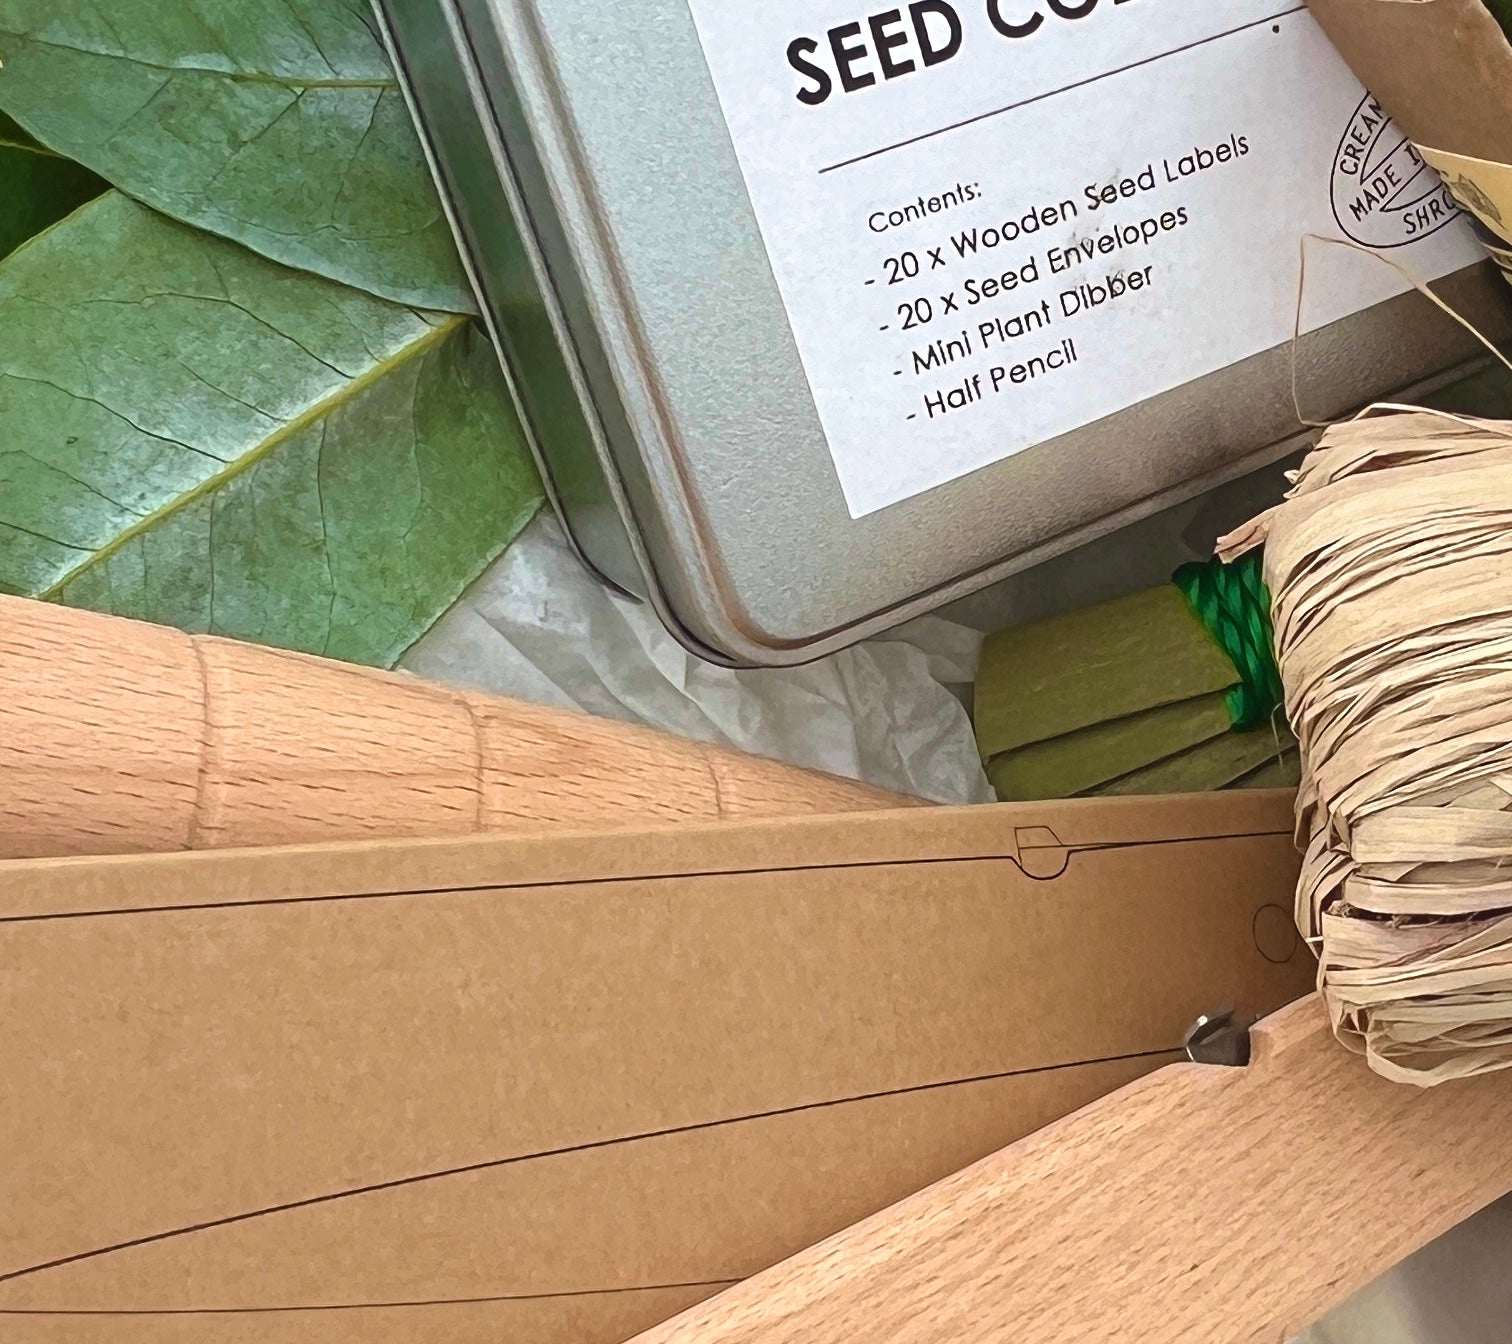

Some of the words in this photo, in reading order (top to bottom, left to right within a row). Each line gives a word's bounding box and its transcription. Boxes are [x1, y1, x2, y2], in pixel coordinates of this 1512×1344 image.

[868, 182, 983, 233] Contents:
[883, 252, 920, 285] 20
[927, 247, 946, 270] x
[951, 199, 1078, 259] Wooden
[1084, 164, 1156, 210] Seed
[1163, 133, 1250, 183] Labels
[1349, 164, 1402, 222] MADE
[897, 296, 933, 330] 20
[943, 292, 959, 316] x
[963, 256, 1040, 306] Seed
[1048, 205, 1189, 274] Envelopes
[911, 330, 972, 375] Mini
[978, 300, 1051, 349] Plant
[1060, 264, 1153, 317] Dibber
[924, 373, 983, 419] Half
[989, 337, 1078, 392] Pencil
